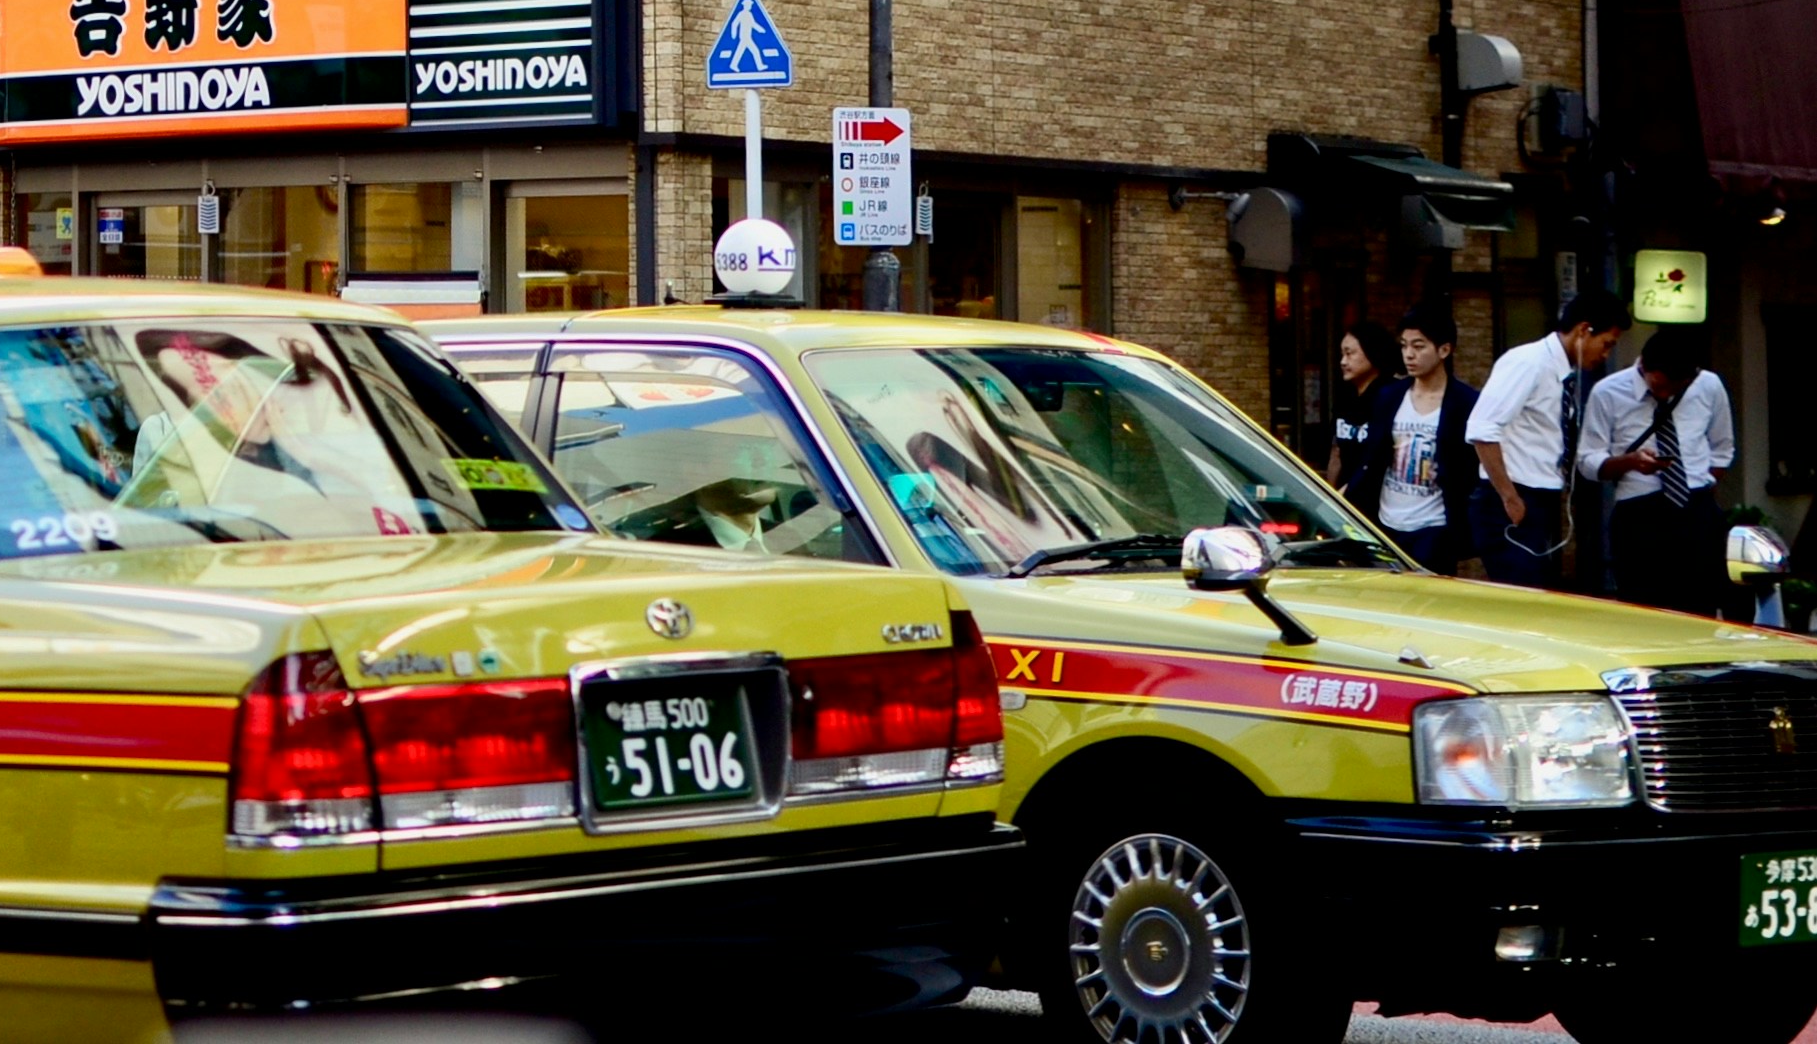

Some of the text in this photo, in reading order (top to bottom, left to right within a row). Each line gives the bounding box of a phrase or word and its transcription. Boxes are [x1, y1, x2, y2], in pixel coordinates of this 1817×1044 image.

[77, 67, 270, 117] YOSHINOYA
[415, 54, 588, 95] YOSHINOYA
[859, 224, 907, 236] バスのりば
[10, 512, 117, 549] 2209
[1281, 675, 1378, 712] (武蔵野)
[666, 697, 709, 729] 500
[622, 732, 744, 797] 51-06
